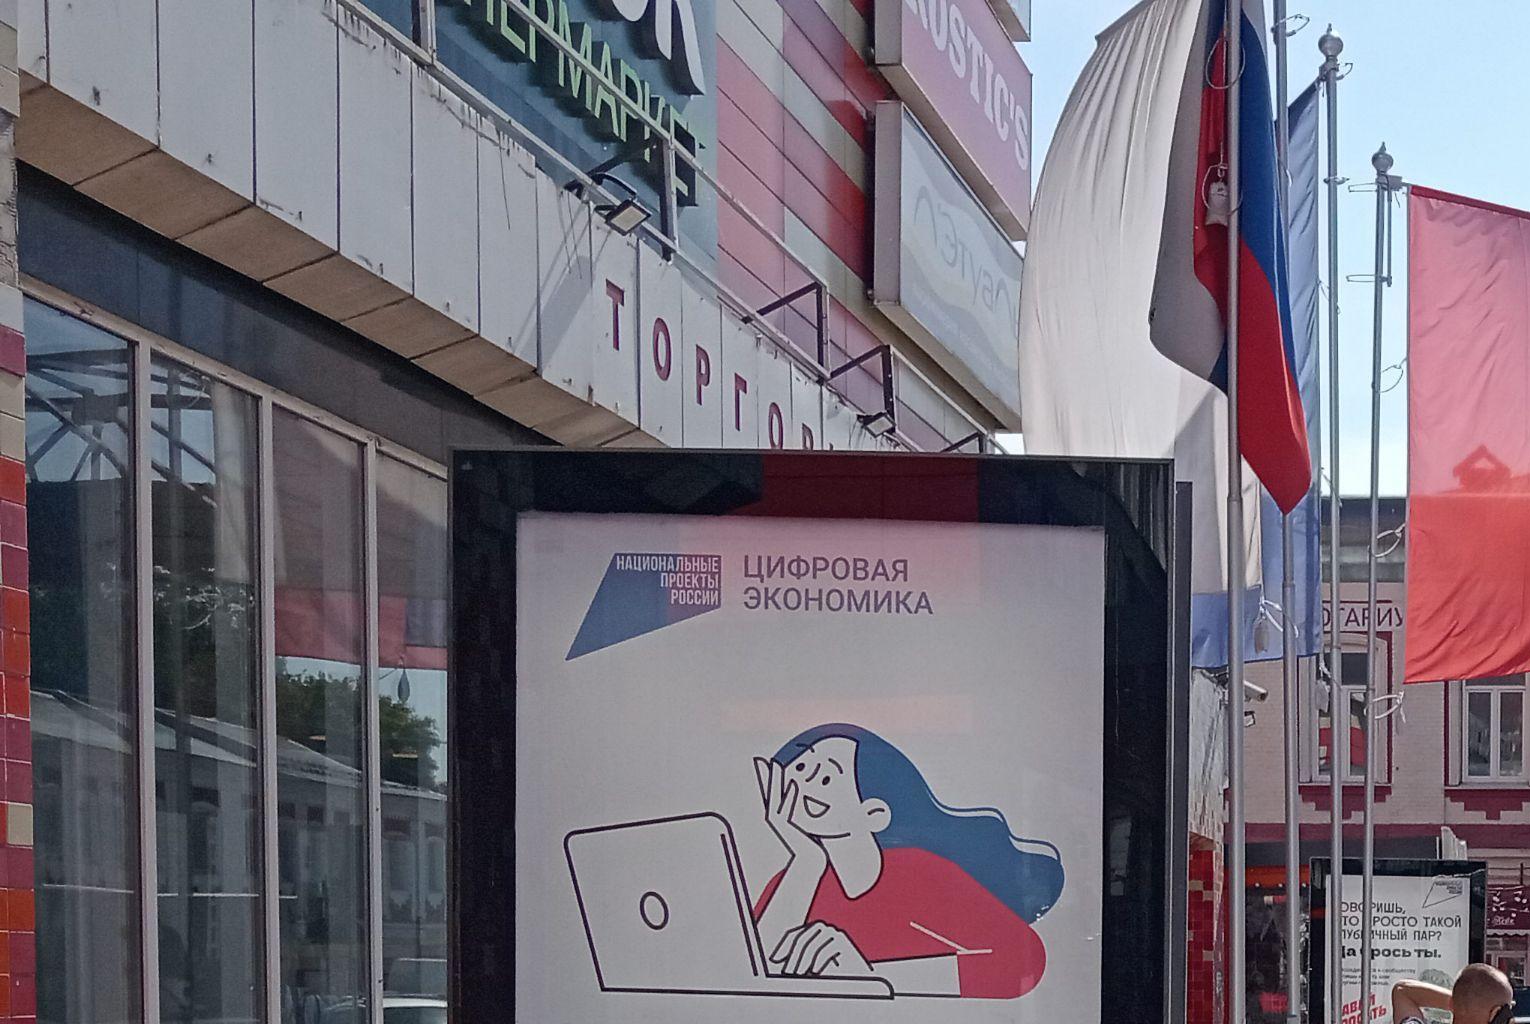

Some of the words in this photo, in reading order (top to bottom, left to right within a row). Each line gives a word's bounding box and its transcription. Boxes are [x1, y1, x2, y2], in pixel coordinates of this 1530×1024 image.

[605, 278, 835, 450] ТОРГО
[616, 555, 720, 573] НАЦИОНАЛЬНЫЕ
[743, 555, 909, 583] ЦИФРОВАЯ
[660, 572, 720, 589] ПРОЕКТЫ
[670, 589, 720, 606] РОССИИ
[743, 586, 934, 615] ЭКОНОМИКА
[1341, 917, 1360, 928] ТО
[1373, 917, 1417, 928] РОСТО
[1423, 915, 1462, 928] ТАКОЙ
[1413, 930, 1442, 941] ПАР?
[1360, 947, 1411, 960] рось
[1414, 947, 1442, 958] ты.
